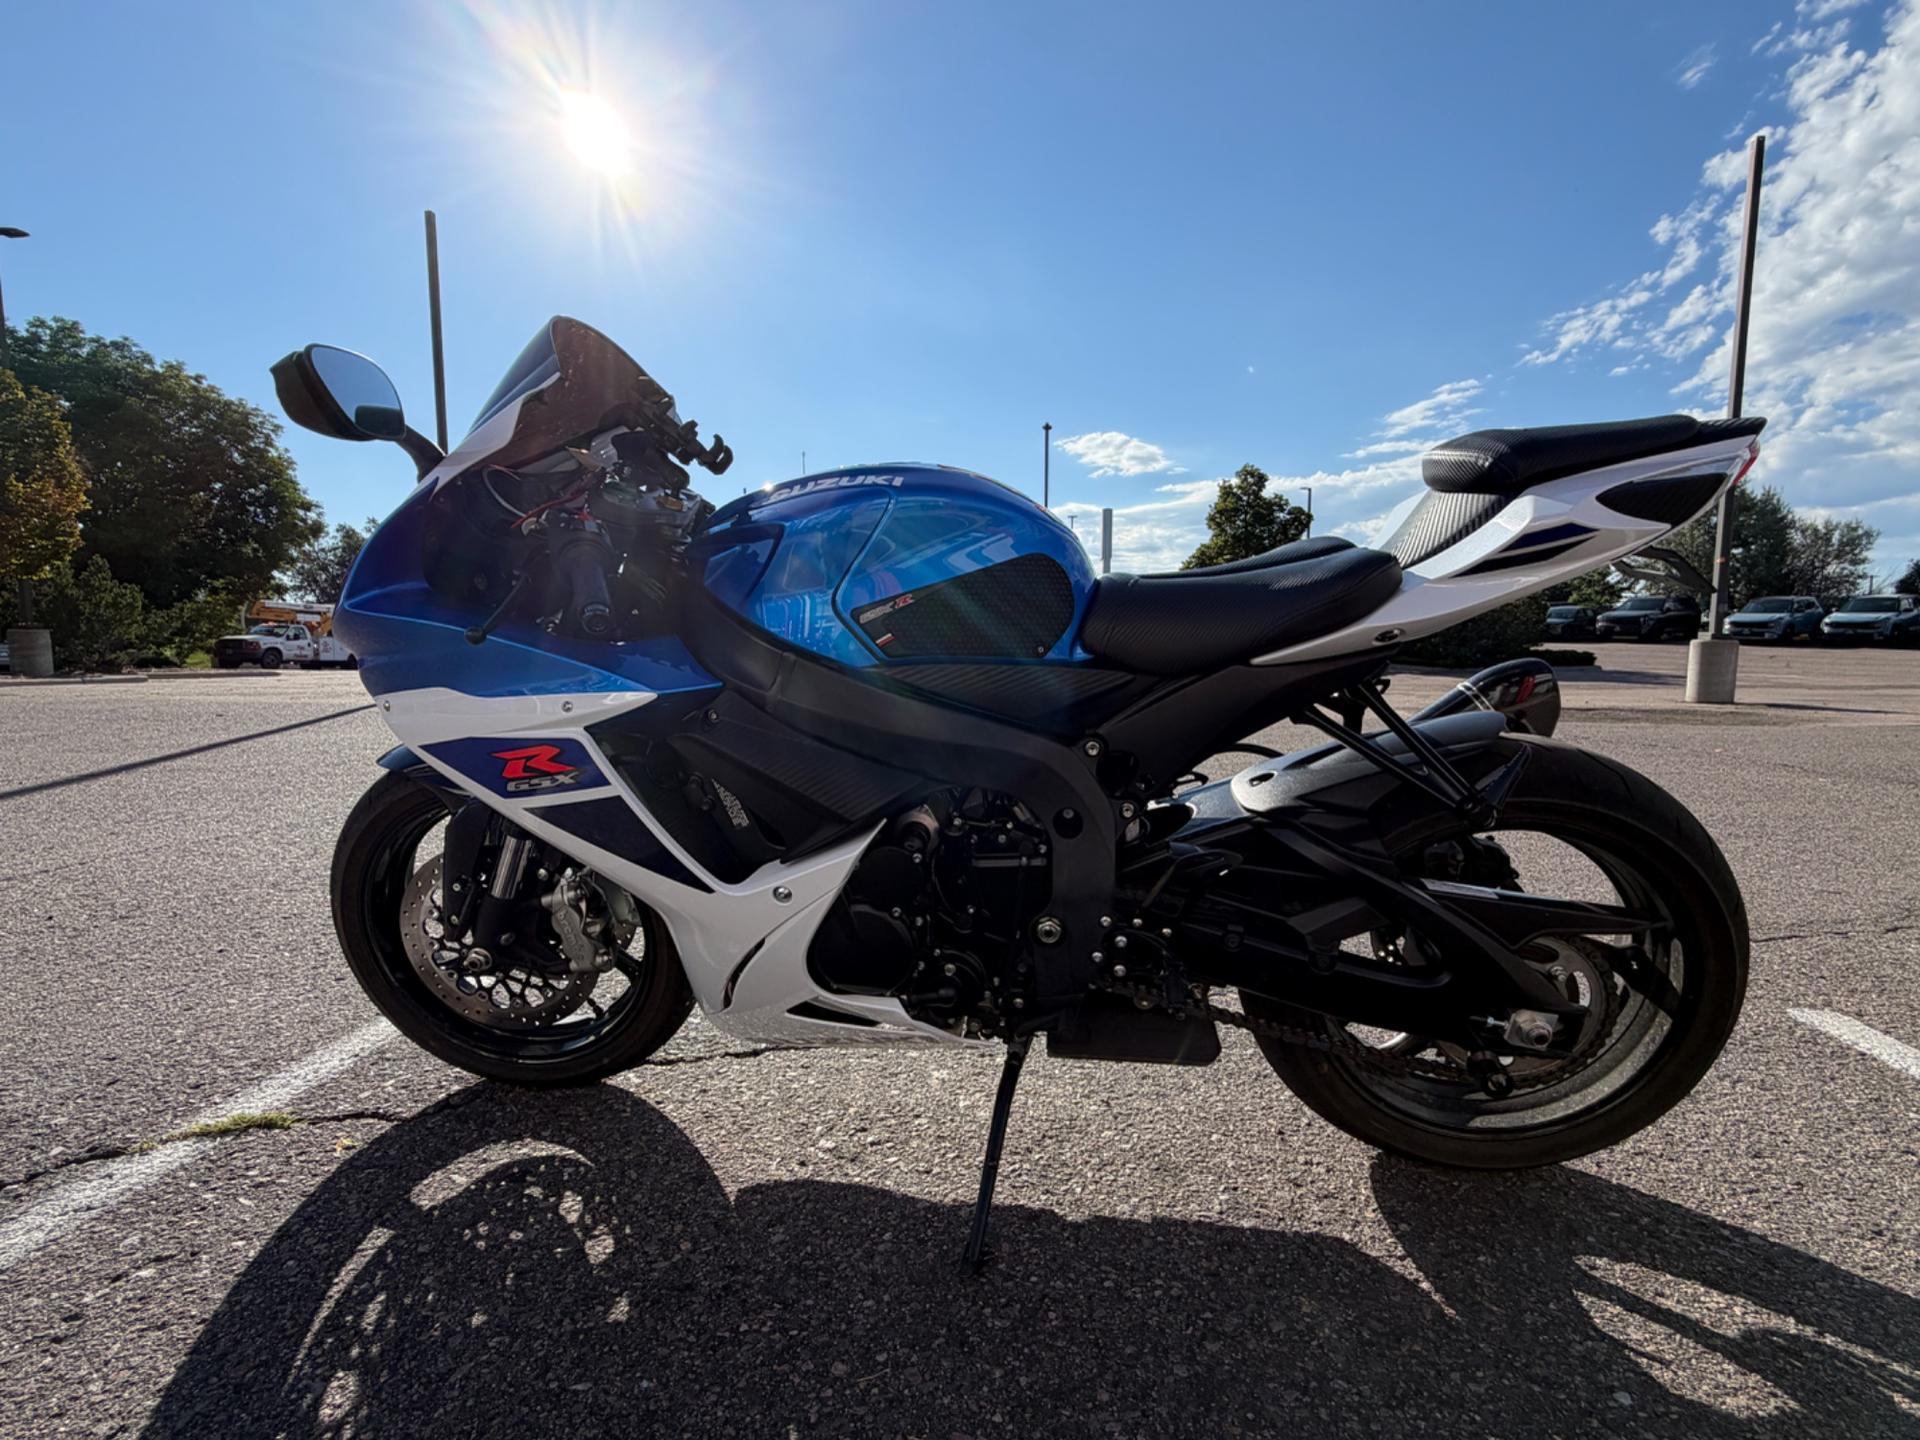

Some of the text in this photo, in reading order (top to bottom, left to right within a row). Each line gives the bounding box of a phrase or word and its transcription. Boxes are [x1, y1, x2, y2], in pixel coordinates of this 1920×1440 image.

[751, 475, 904, 507] SUZUKI
[490, 745, 577, 779] R
[506, 771, 580, 792] GSX
